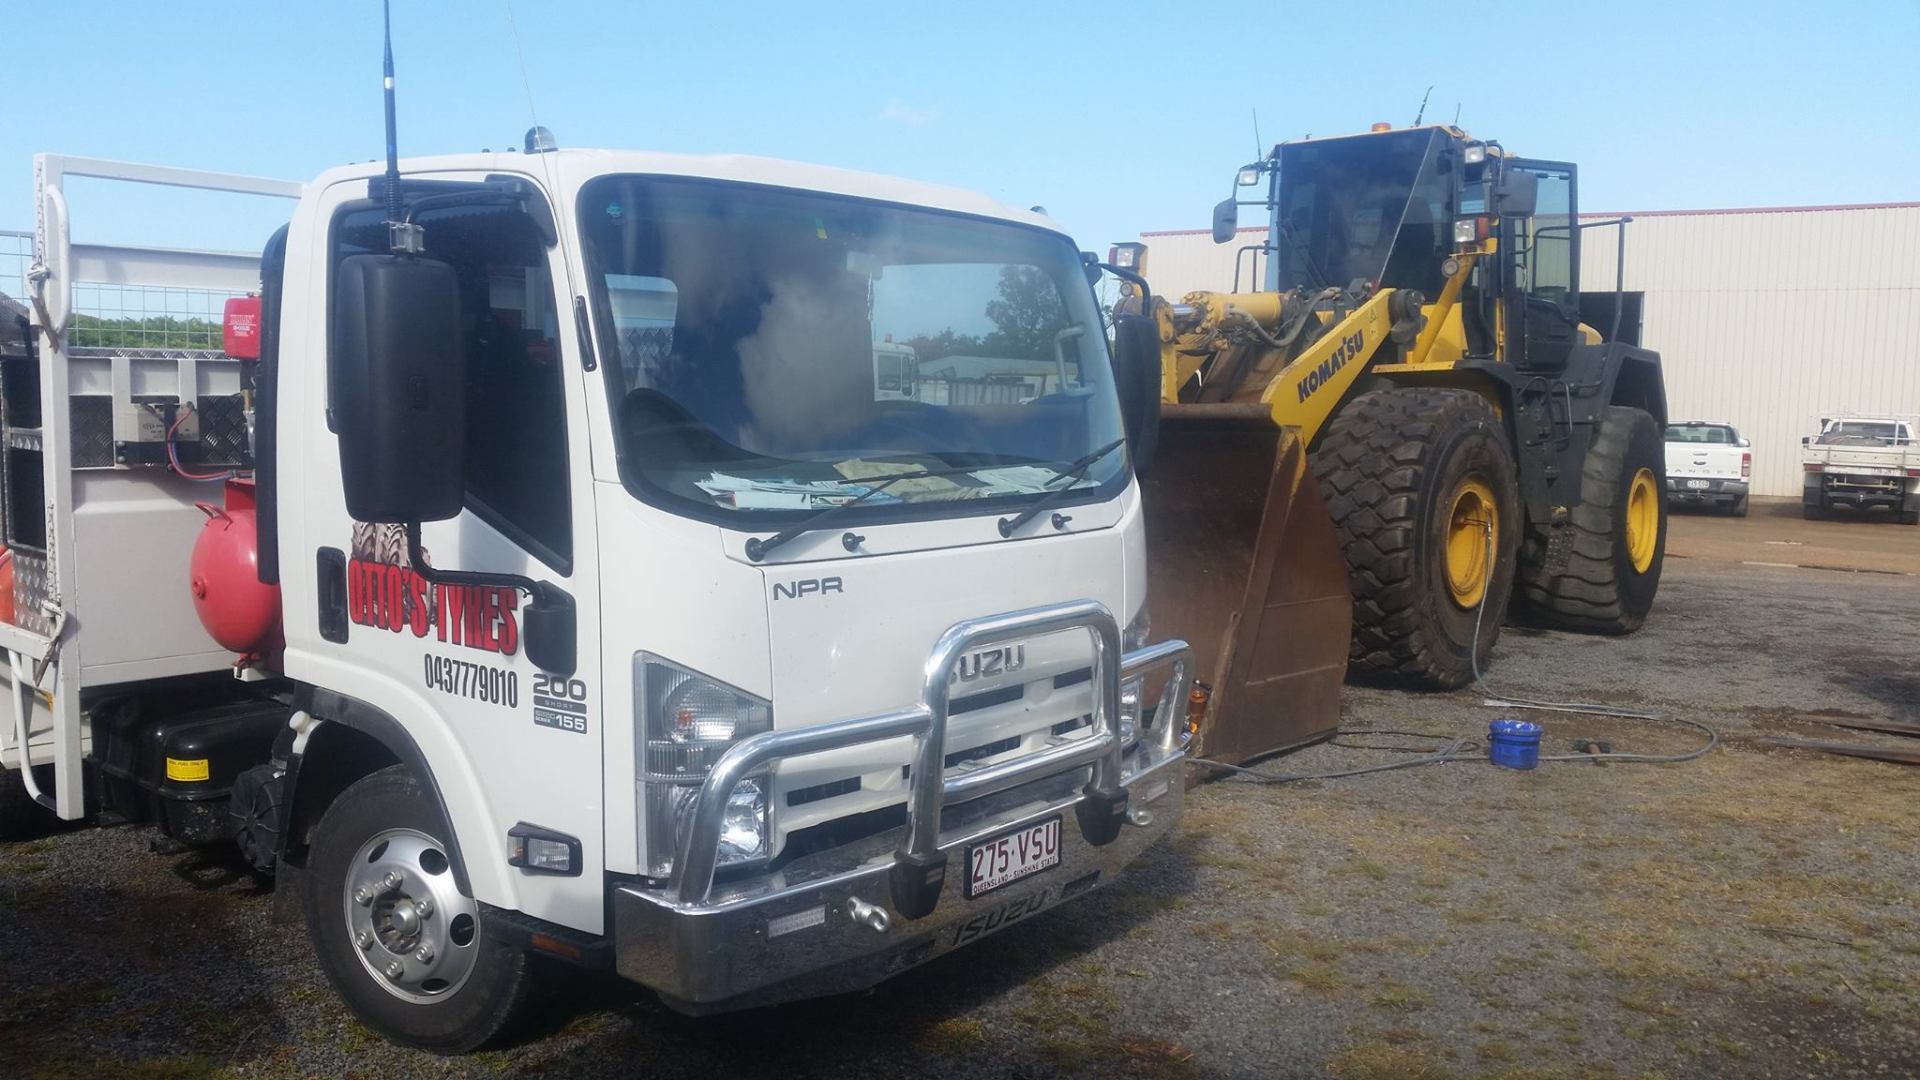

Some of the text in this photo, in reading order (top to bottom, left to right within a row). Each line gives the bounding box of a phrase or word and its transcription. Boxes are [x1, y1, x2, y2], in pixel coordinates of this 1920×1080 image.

[773, 576, 843, 601] NPR
[425, 653, 518, 709] 0437779010
[950, 644, 1025, 684] UZU
[533, 673, 586, 701] 200
[556, 714, 585, 731] 155
[951, 889, 1048, 946] ISUZU
